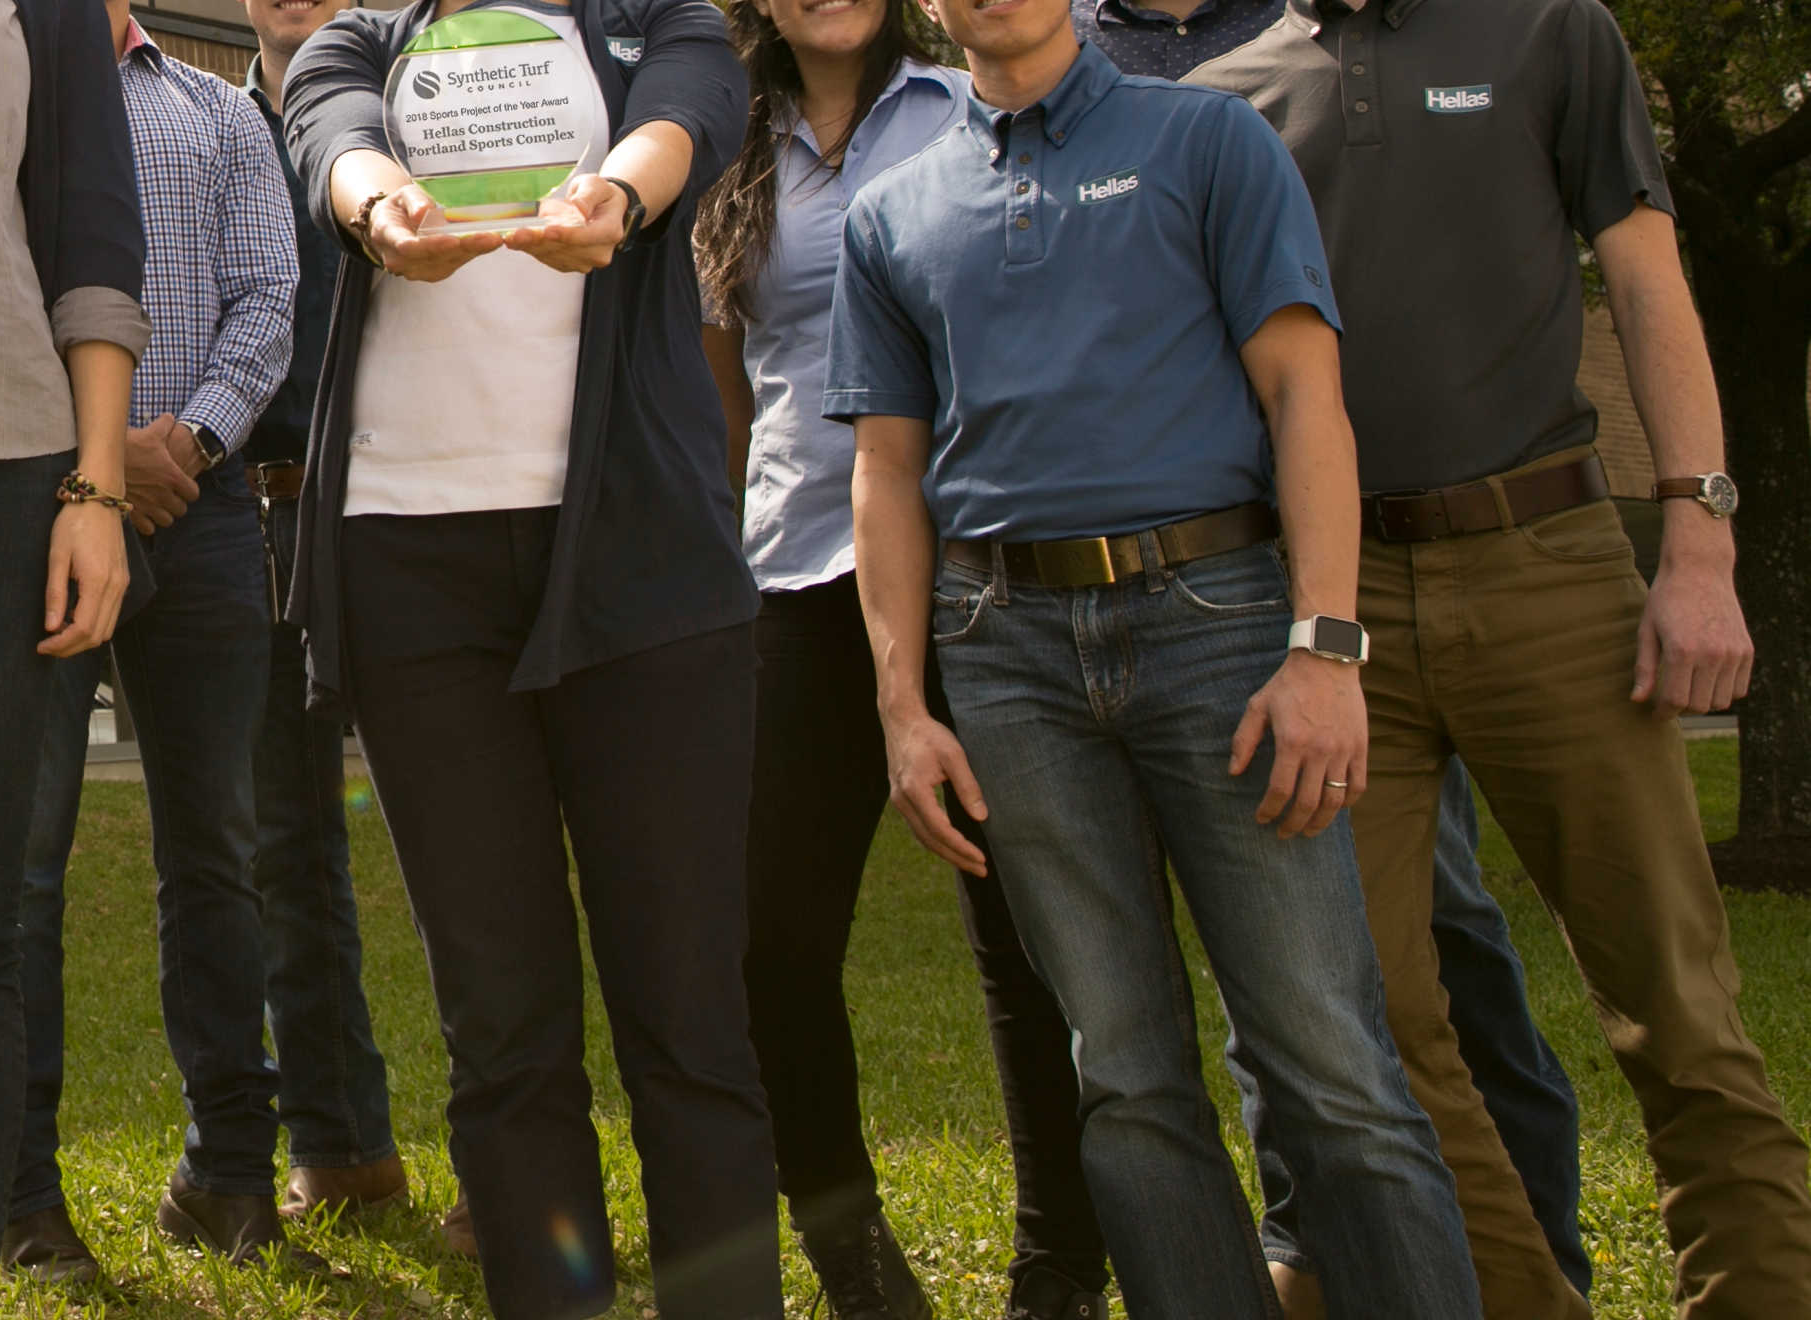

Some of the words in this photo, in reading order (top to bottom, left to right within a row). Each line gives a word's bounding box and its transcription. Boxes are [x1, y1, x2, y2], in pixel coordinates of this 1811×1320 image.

[608, 41, 642, 62] llas
[448, 65, 516, 88] Synthetic
[518, 60, 551, 78] Turf
[467, 80, 532, 93] COUNCIL
[406, 112, 428, 123] 2018
[429, 110, 459, 121] Sports
[460, 105, 491, 117] Project
[493, 104, 502, 113] of
[504, 103, 518, 112] the
[520, 100, 539, 110] Year
[540, 96, 569, 107] Award
[1428, 90, 1490, 109] Hellas
[423, 126, 466, 140] Hellas
[468, 116, 556, 135] Construction
[408, 140, 466, 157] Portland
[469, 136, 514, 152] Sports
[515, 129, 576, 145] Complex
[1079, 175, 1139, 202] Hellas
